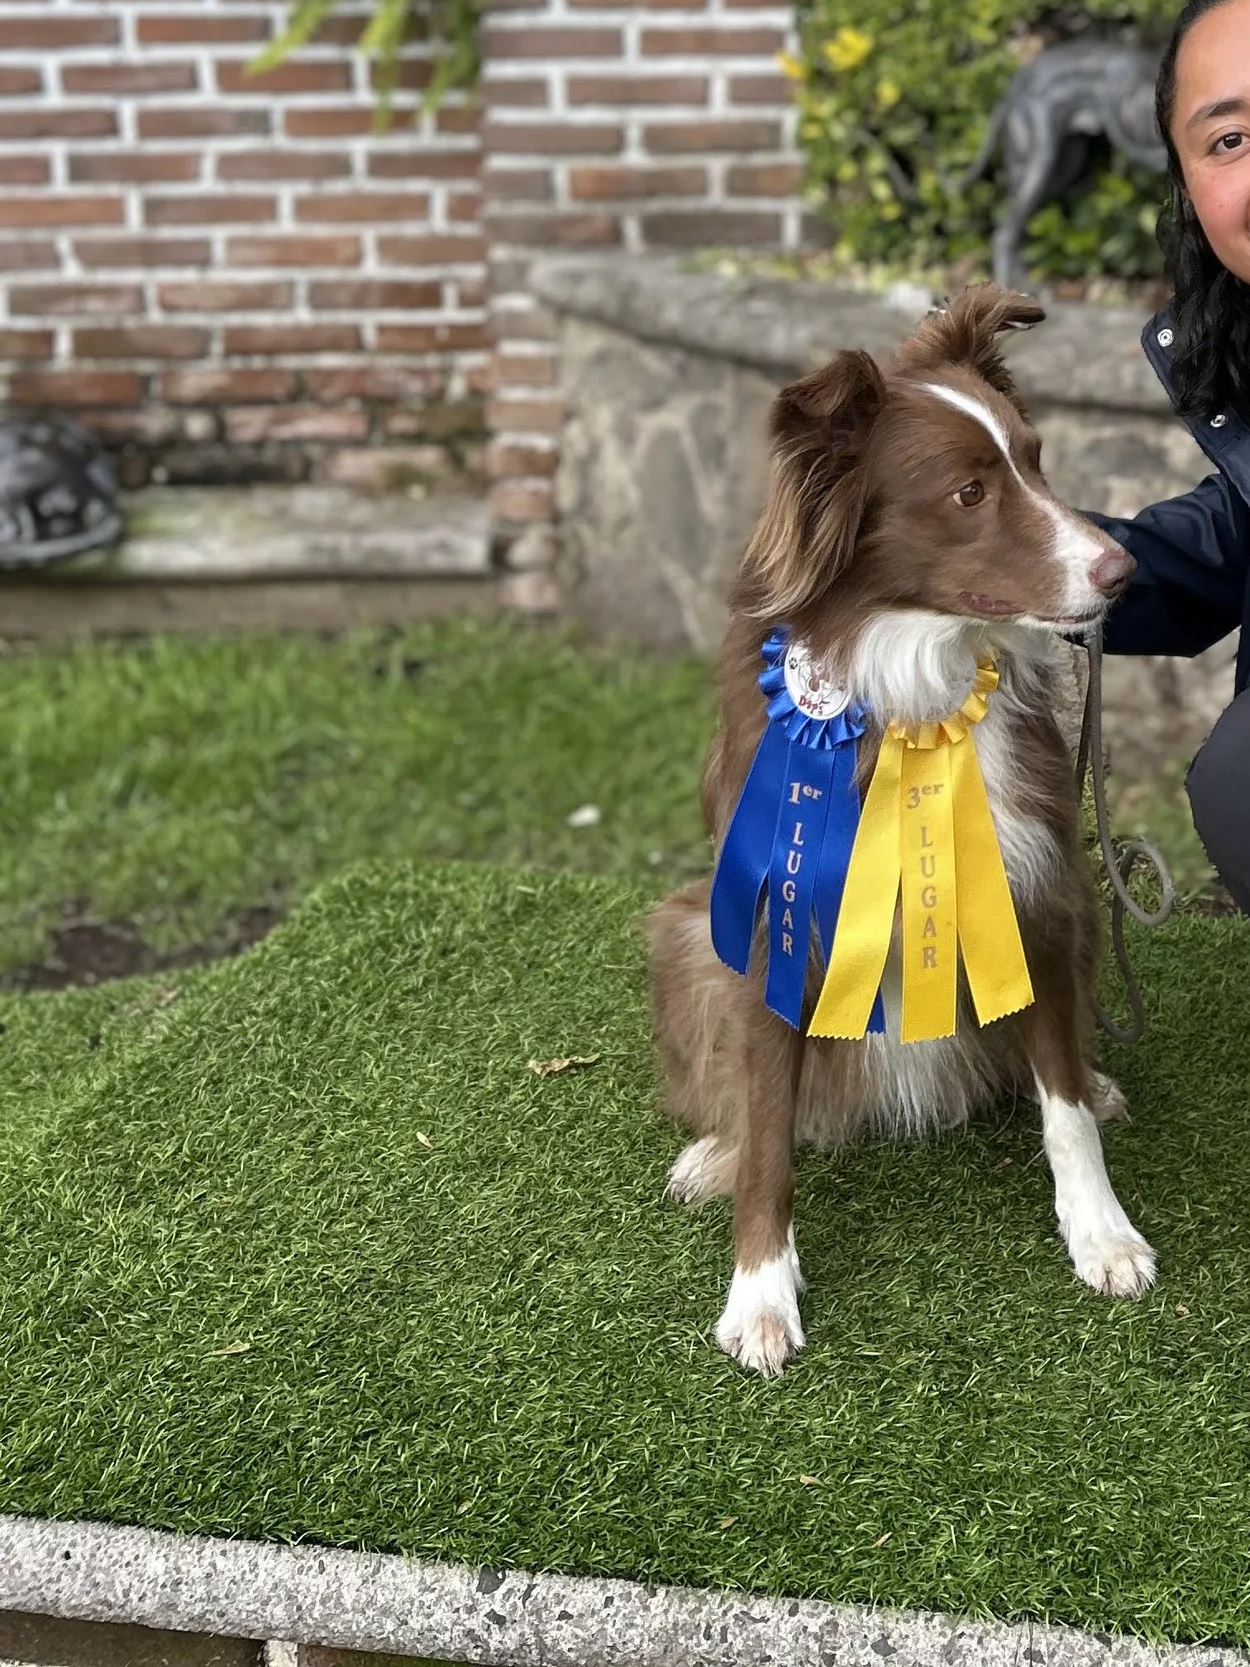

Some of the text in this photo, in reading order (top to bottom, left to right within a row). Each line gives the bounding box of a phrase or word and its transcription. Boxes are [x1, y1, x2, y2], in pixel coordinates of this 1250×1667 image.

[787, 781, 823, 805] 1er
[907, 783, 944, 810] 3er
[782, 821, 804, 957] LUGAR
[920, 825, 938, 970] LUGAR
